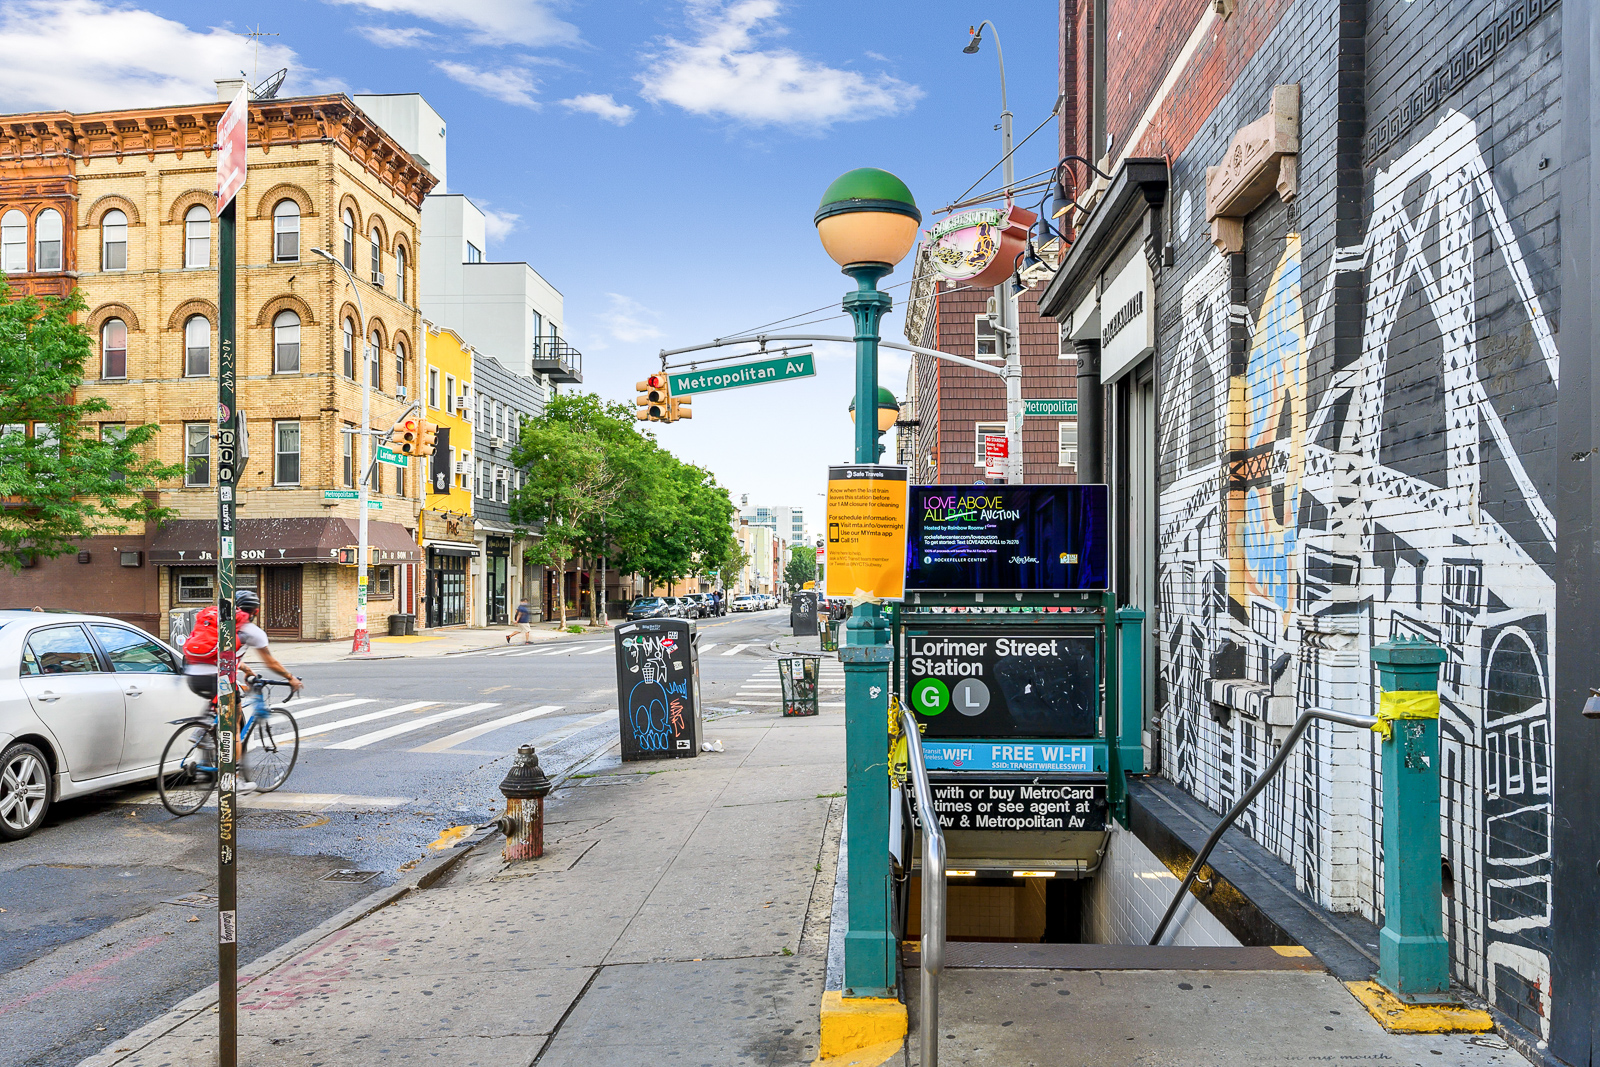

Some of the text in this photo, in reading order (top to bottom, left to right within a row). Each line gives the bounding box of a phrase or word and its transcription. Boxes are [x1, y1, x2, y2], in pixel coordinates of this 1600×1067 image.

[678, 361, 804, 391] Metropolitan Av
[1025, 401, 1077, 414] Metropolitan
[380, 449, 396, 461] Lorimer
[924, 496, 1002, 509] LOVE ABOVE
[924, 509, 1020, 521] ALL BALL AUCTION
[852, 522, 904, 530] mta.info/overnight
[241, 550, 265, 559] SON
[911, 638, 1058, 657] Lorimer Street
[911, 657, 983, 676] Station
[921, 686, 980, 708] G L
[992, 746, 1034, 761] FREE
[1042, 747, 1086, 762] WI-FI
[1010, 762, 1087, 770] TRANSITWIRELESSWIFI
[936, 787, 1094, 801] with or buy MetroCard
[934, 801, 1090, 815] times or see agent at
[939, 815, 1086, 830] Av & Metropolitan Av
